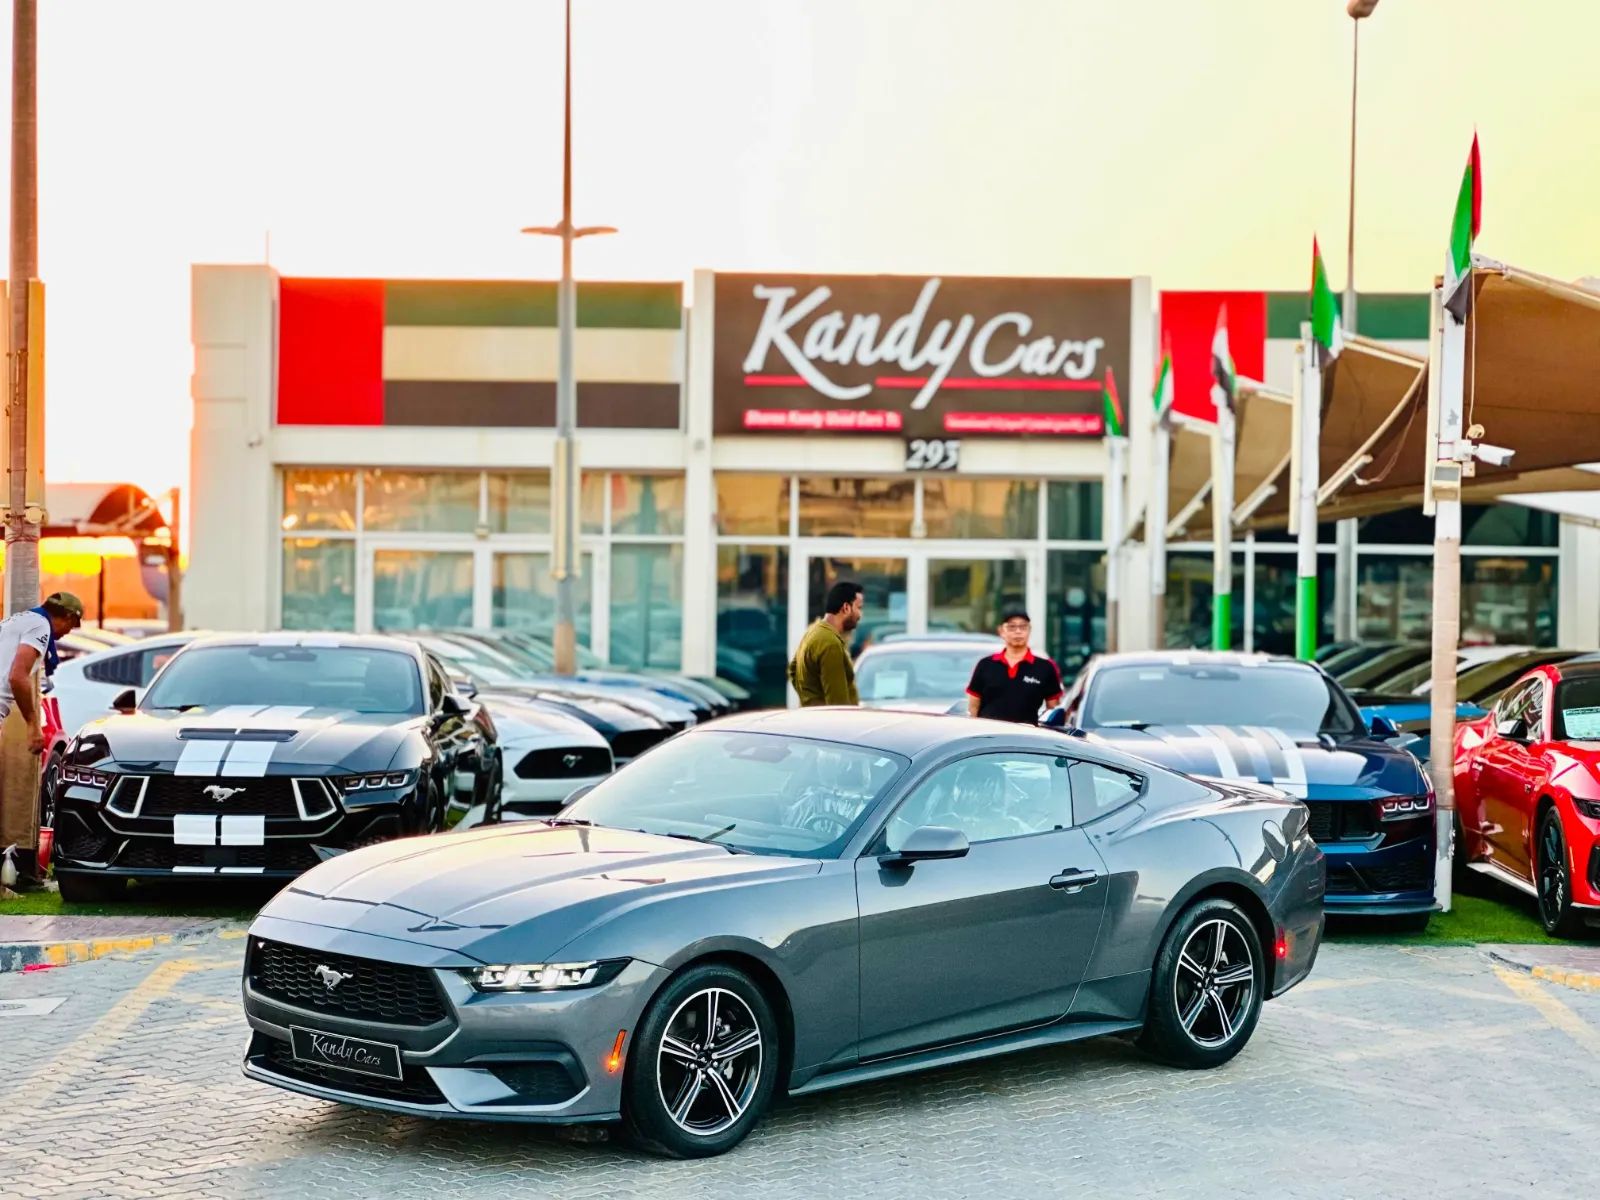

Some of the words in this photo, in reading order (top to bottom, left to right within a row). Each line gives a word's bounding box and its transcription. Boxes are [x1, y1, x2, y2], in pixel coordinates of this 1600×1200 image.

[743, 277, 975, 410] Kandy
[969, 312, 1105, 379] Cars
[905, 438, 961, 470] 295
[310, 1033, 353, 1063] Kandy
[354, 1047, 381, 1065] Cars
